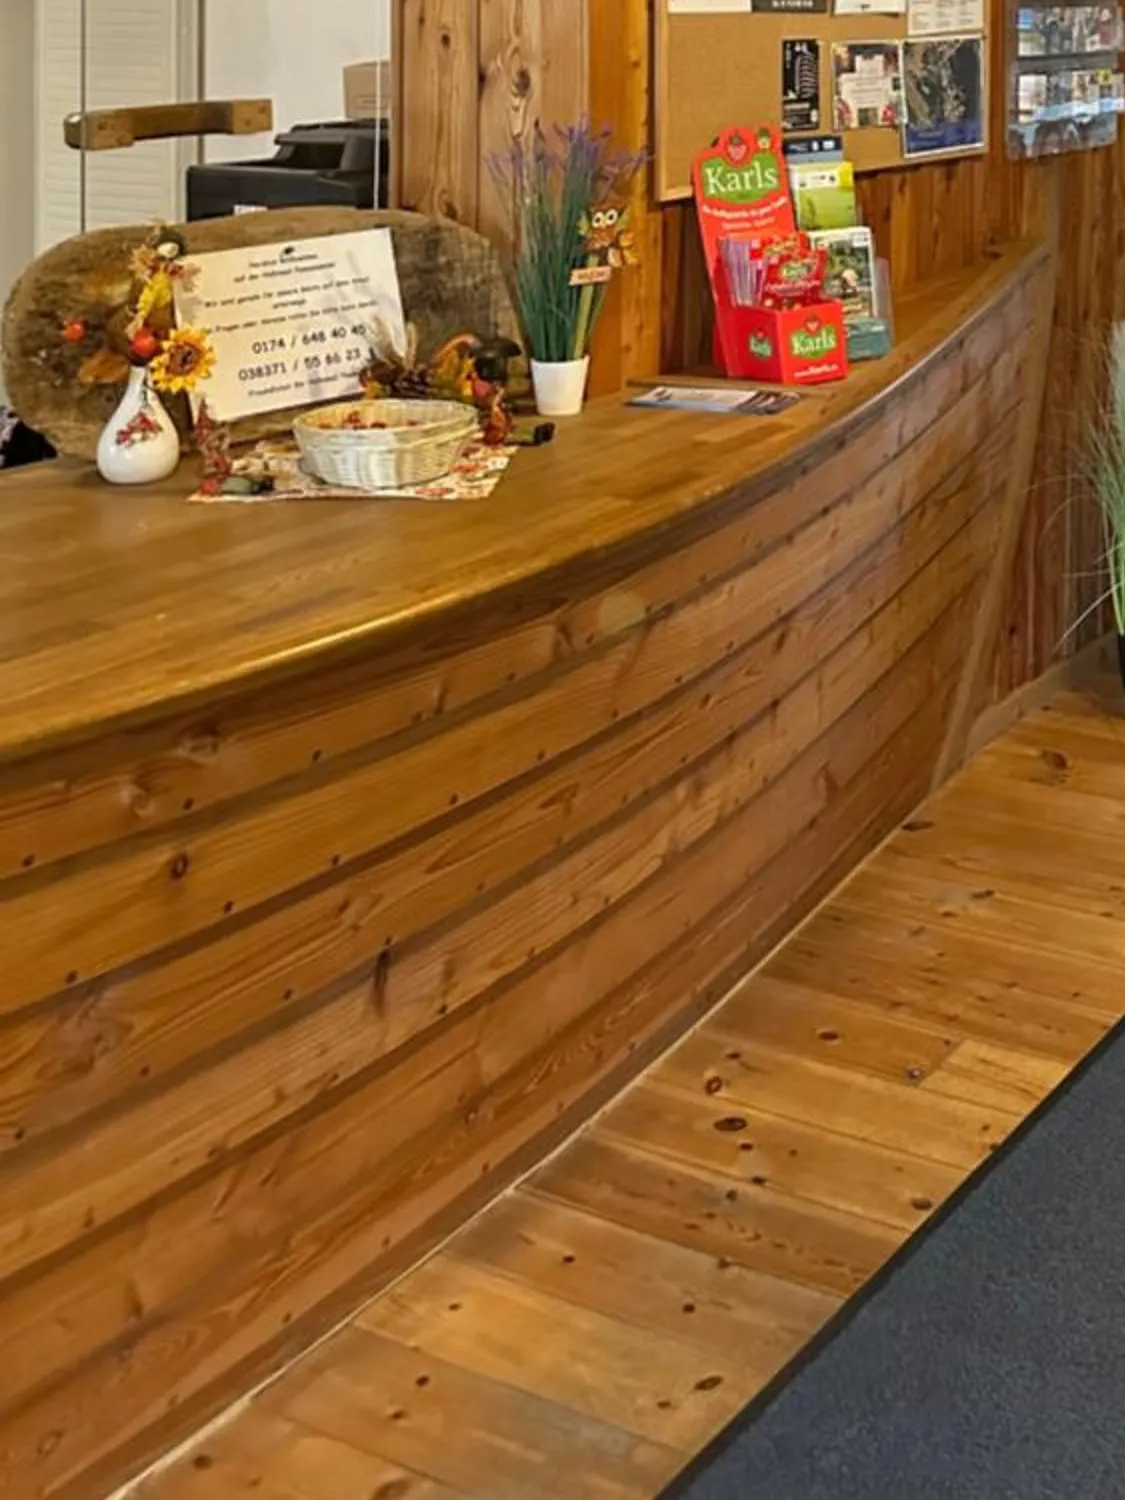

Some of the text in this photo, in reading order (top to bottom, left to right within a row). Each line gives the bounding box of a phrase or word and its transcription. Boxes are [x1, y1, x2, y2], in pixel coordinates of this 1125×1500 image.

[705, 160, 778, 195] Karls
[251, 338, 287, 355] 0174
[332, 326, 347, 339] 40
[790, 327, 838, 357] Karls
[237, 361, 287, 382] 038371
